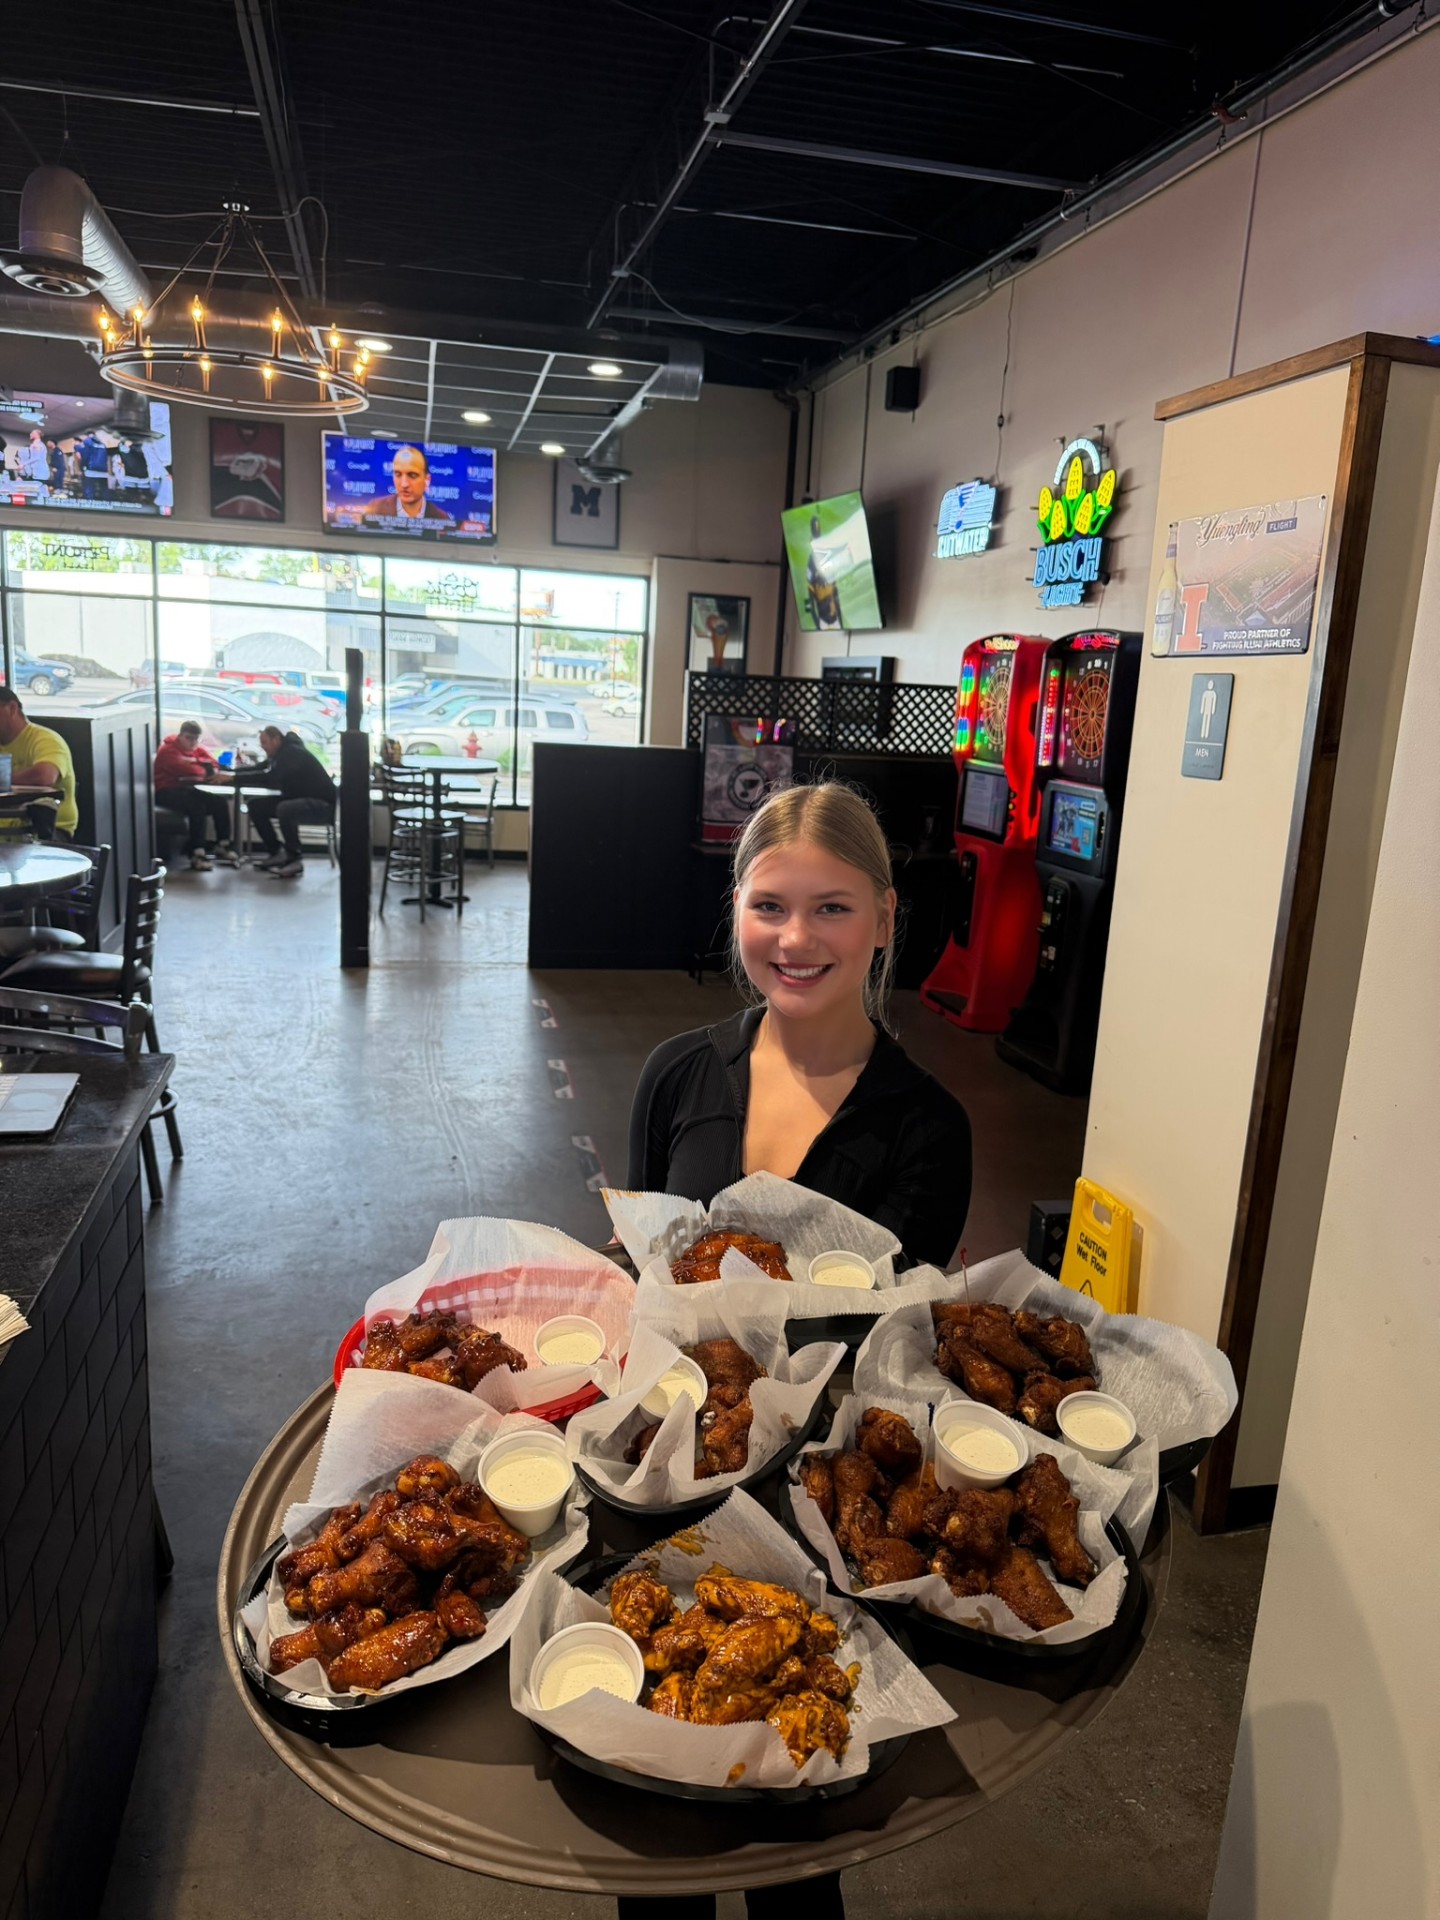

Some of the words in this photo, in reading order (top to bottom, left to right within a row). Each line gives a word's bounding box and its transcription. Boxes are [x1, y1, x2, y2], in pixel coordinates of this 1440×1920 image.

[570, 484, 602, 518] M
[1196, 508, 1266, 548] Yuengling
[1268, 520, 1293, 532] FLIGHT
[1212, 641, 1243, 650] FIGHTING
[1263, 638, 1301, 648] ATHLETICS
[1223, 630, 1247, 640] PROUD
[1247, 629, 1279, 639] PARTNER
[1280, 628, 1292, 637] OF
[1194, 748, 1209, 757] MEN
[1079, 1232, 1107, 1261] CAUTION
[1077, 1244, 1088, 1262] Wet
[1091, 1255, 1107, 1277] Floor
